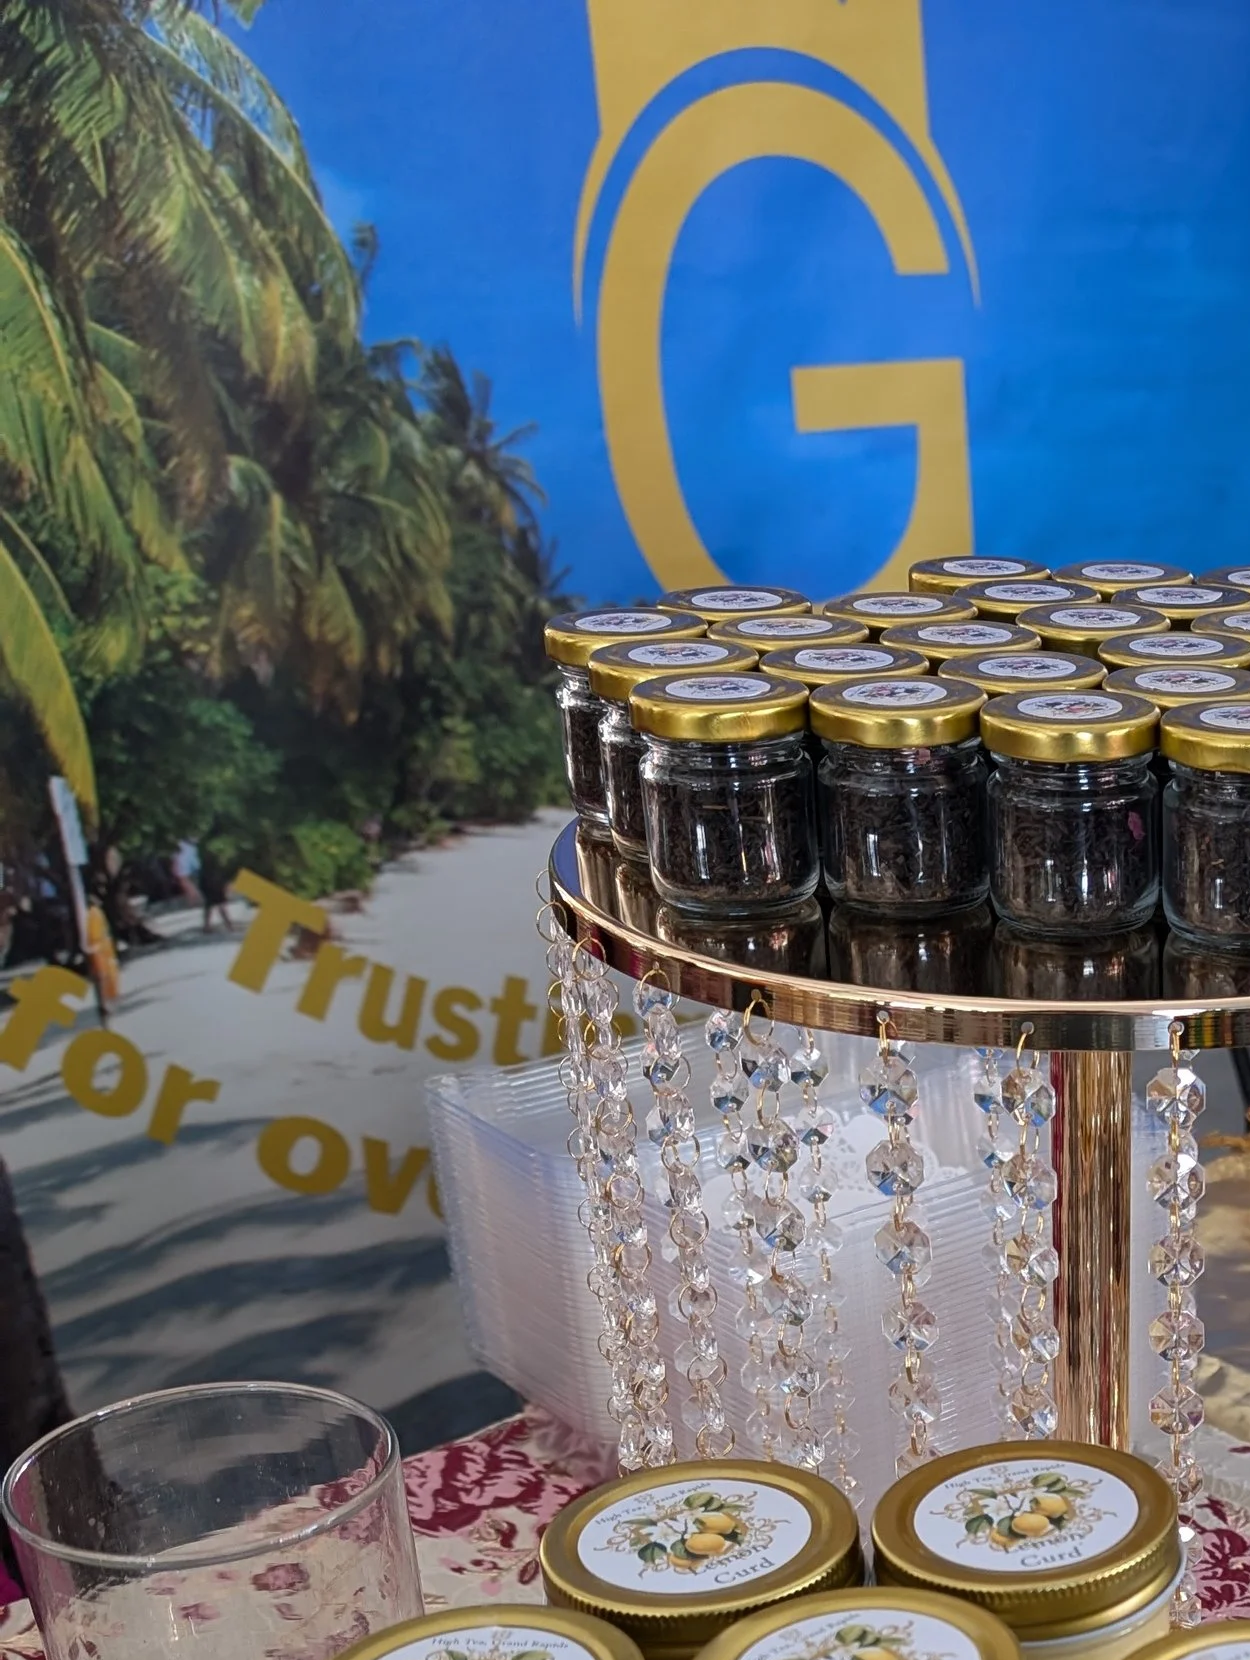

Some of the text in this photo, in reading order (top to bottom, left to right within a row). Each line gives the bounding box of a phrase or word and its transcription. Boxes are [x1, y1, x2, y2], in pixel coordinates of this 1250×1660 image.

[0, 962, 446, 1223] for ov
[594, 1510, 620, 1527] High
[1003, 1532, 1085, 1555] Lemon
[688, 1543, 769, 1577] Lemon
[1020, 1545, 1083, 1569] Curd
[713, 1556, 776, 1585] Curd
[431, 1636, 460, 1648] High
